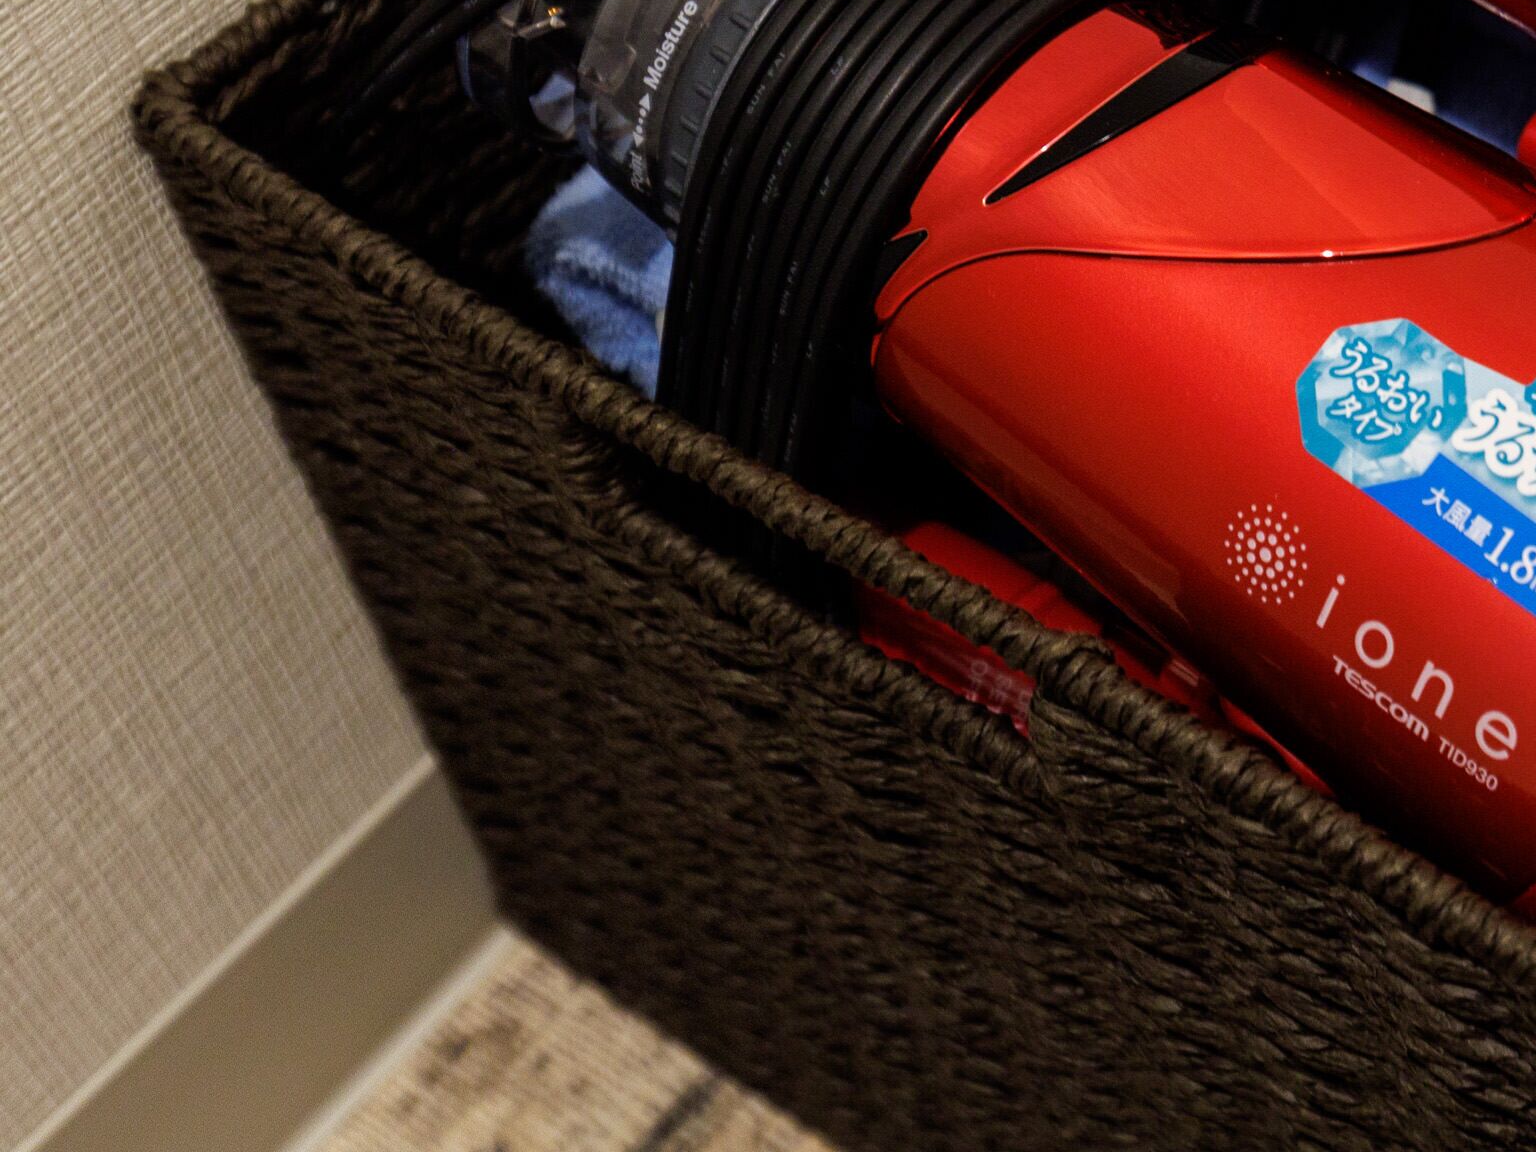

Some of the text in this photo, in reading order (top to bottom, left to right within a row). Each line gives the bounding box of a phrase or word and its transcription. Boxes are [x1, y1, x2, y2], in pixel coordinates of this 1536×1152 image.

[643, 0, 699, 91] Moisture
[1329, 393, 1403, 441] タイプ
[1333, 340, 1443, 429] うるおい
[1316, 573, 1518, 761] ione
[1438, 735, 1499, 792] TID930
